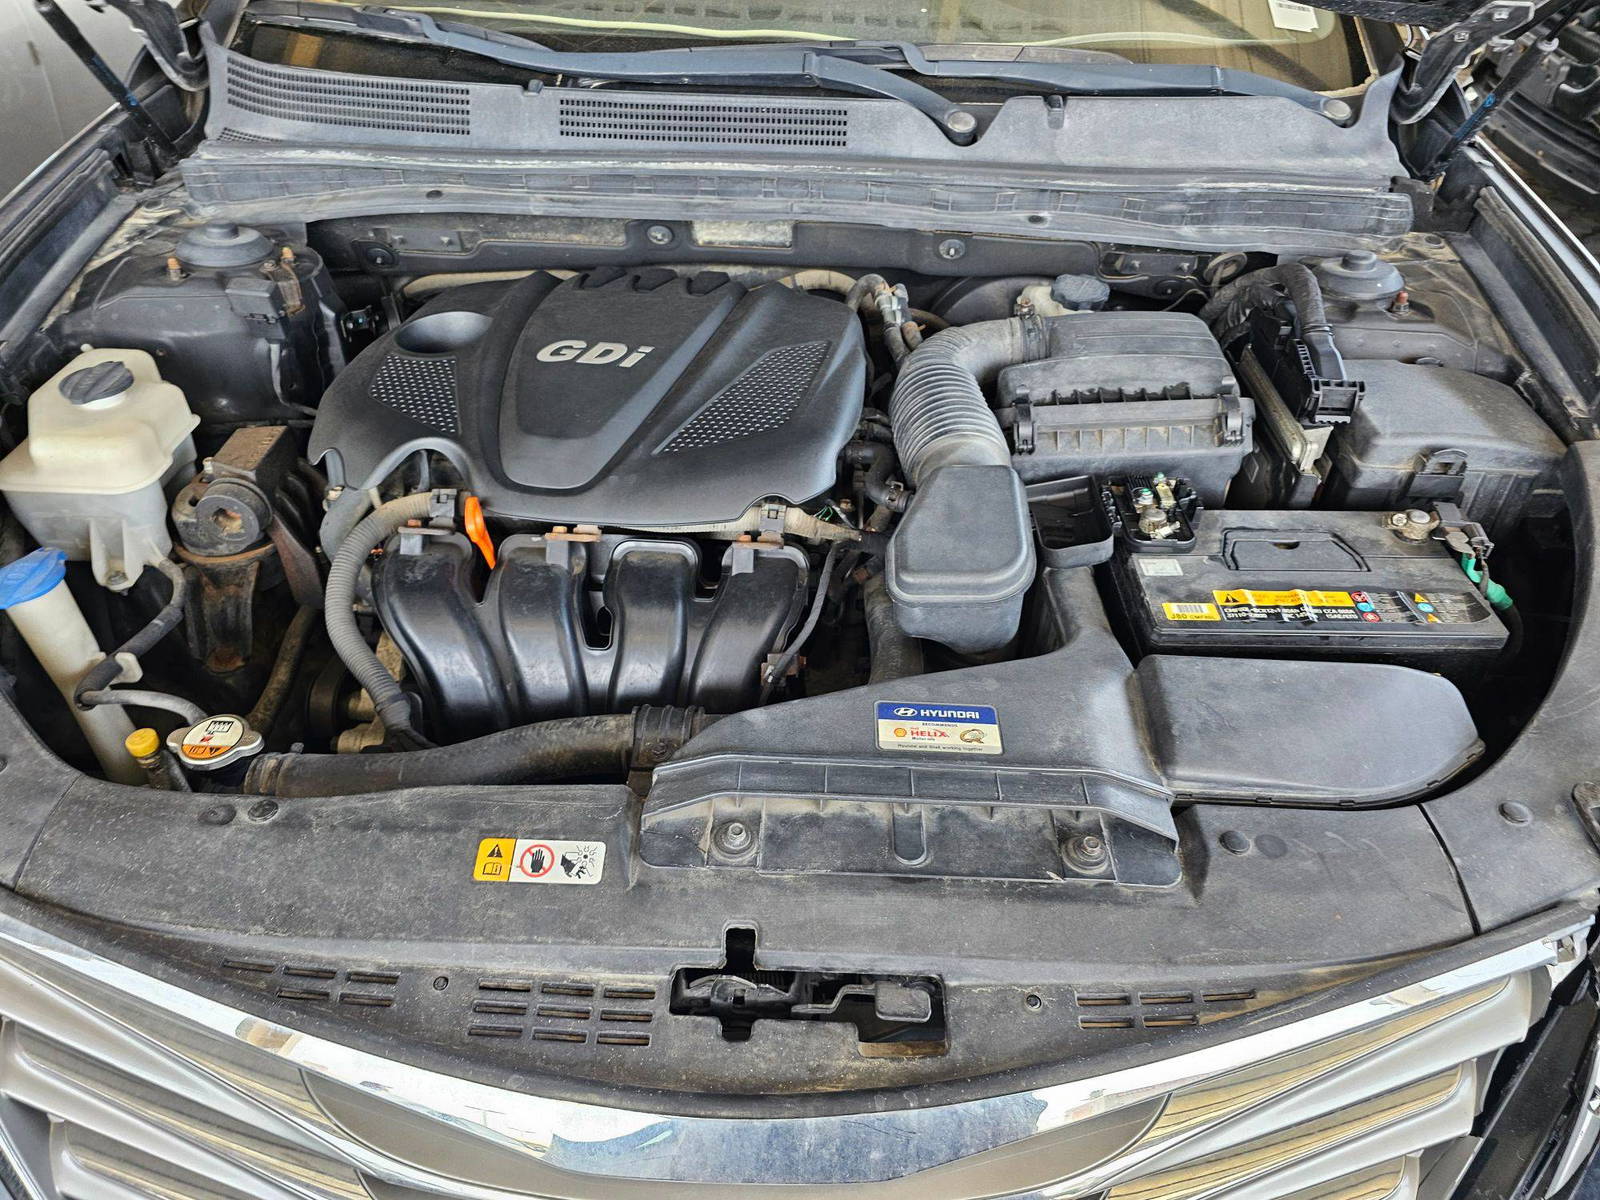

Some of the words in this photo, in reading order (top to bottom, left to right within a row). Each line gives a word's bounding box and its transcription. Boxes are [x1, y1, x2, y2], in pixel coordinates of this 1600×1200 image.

[536, 339, 655, 368] GDi
[920, 709, 980, 719] HYUNDAI
[910, 729, 950, 738] HELIX
